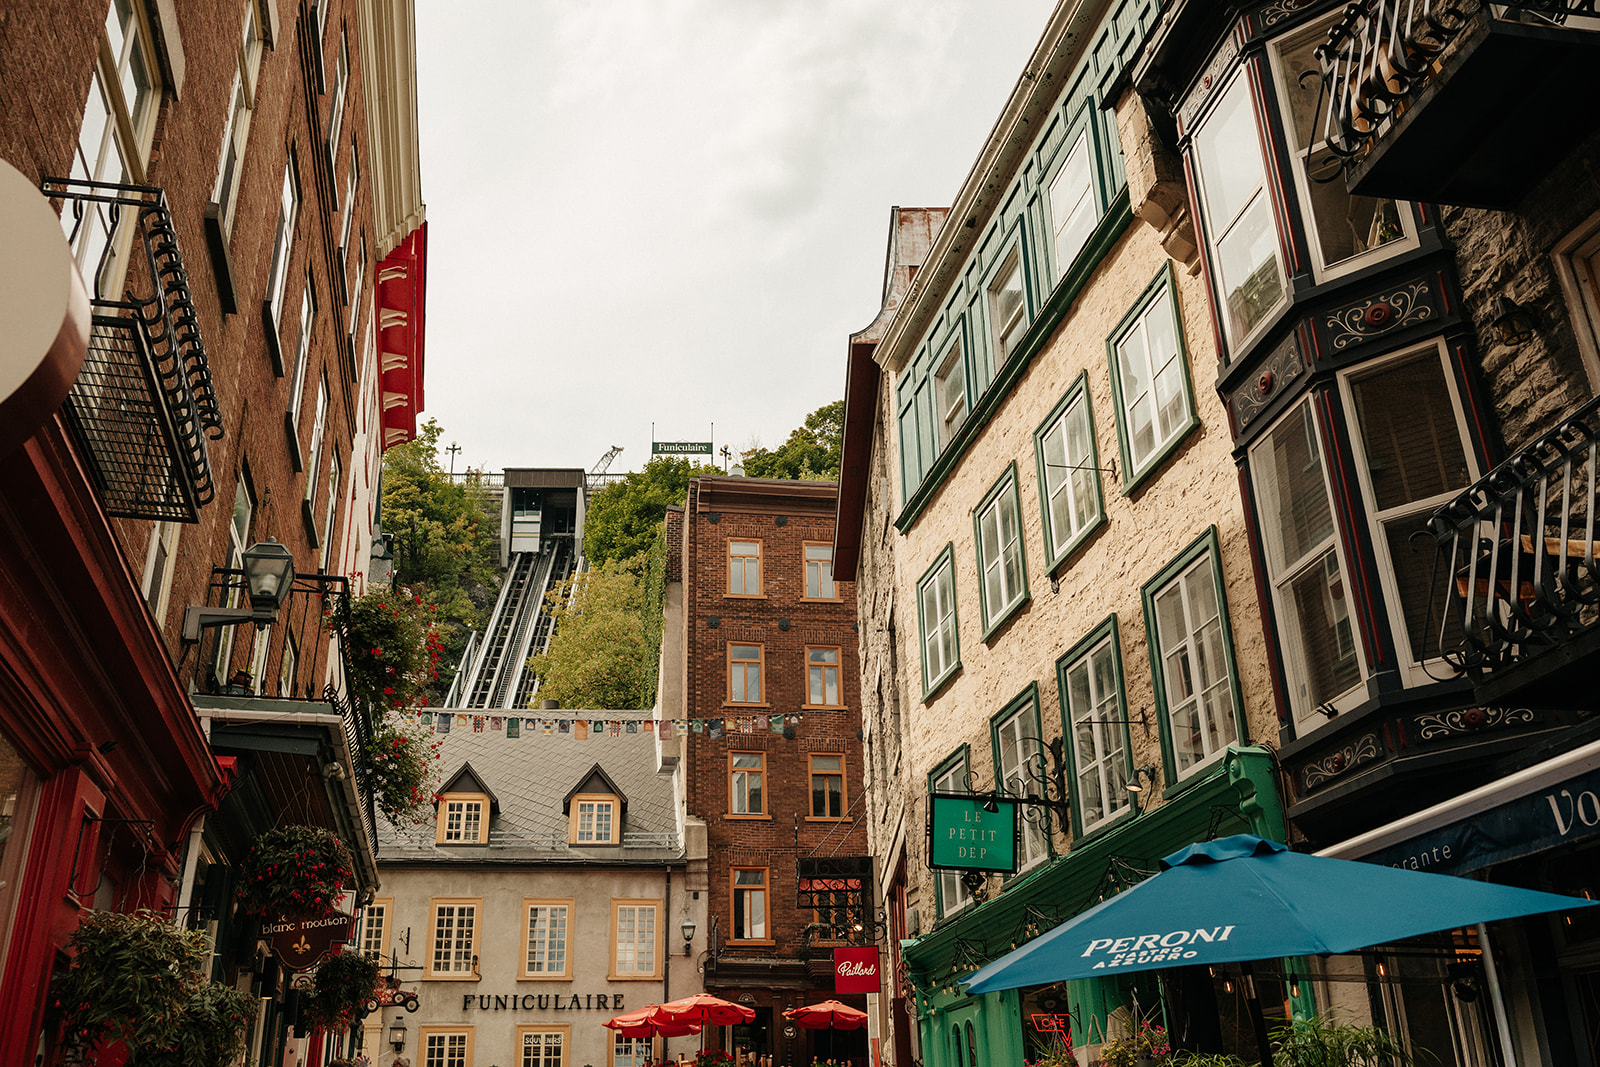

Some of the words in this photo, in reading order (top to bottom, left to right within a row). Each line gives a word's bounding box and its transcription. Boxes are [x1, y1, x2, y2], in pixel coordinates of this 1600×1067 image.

[658, 443, 707, 452] Funiculaire
[964, 810, 982, 823] LE
[949, 827, 997, 842] PETIT
[958, 846, 987, 859] DEP
[262, 922, 296, 934] blanc
[301, 917, 348, 929] mouton
[1080, 925, 1236, 958] PERONI
[1092, 950, 1198, 970] AZZURRO
[1114, 946, 1184, 960] NASTRO
[837, 960, 876, 977] Paillard
[462, 993, 625, 1011] FUNICULAIRE
